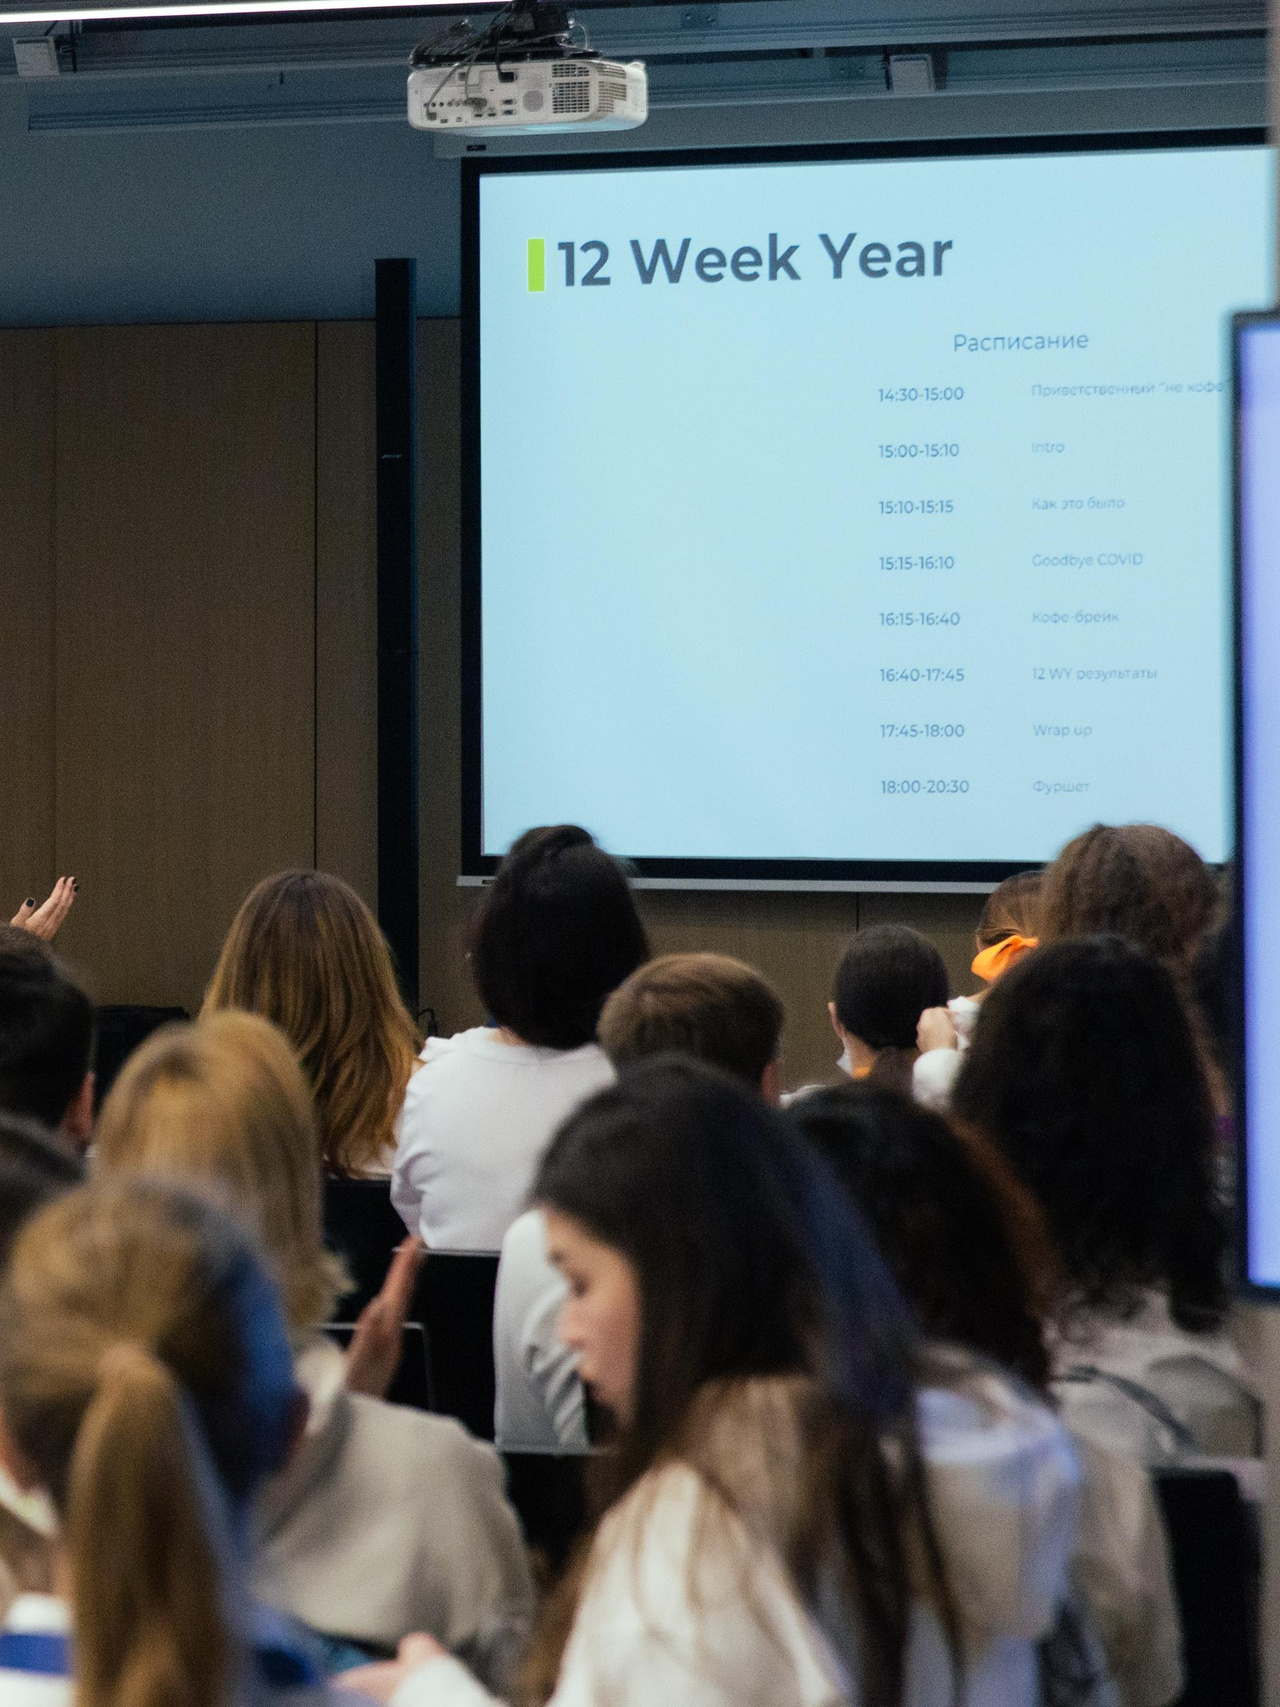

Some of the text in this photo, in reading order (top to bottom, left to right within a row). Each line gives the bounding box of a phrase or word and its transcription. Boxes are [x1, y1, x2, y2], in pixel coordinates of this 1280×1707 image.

[557, 231, 954, 288] 12 Week Year
[953, 332, 1089, 352] Расписание
[878, 386, 965, 403] 14:30-15:00
[878, 443, 960, 459] 15:00-15:10
[1031, 441, 1065, 454] Intro
[879, 499, 955, 515] 15:10-15:15
[1032, 495, 1126, 511] Как это было
[879, 556, 955, 571] 15:15-16:10
[1032, 552, 1144, 569] Goodbye COVID
[879, 611, 961, 627] 16:15-16:40
[880, 667, 965, 683] 16:40-17:45
[1032, 667, 1158, 682] 12 WY результаты
[880, 723, 966, 738] 17:45-18:00
[1033, 723, 1093, 738] Wrap up
[881, 779, 970, 795] 18:00-20:30
[1033, 780, 1090, 796] Фуршет
